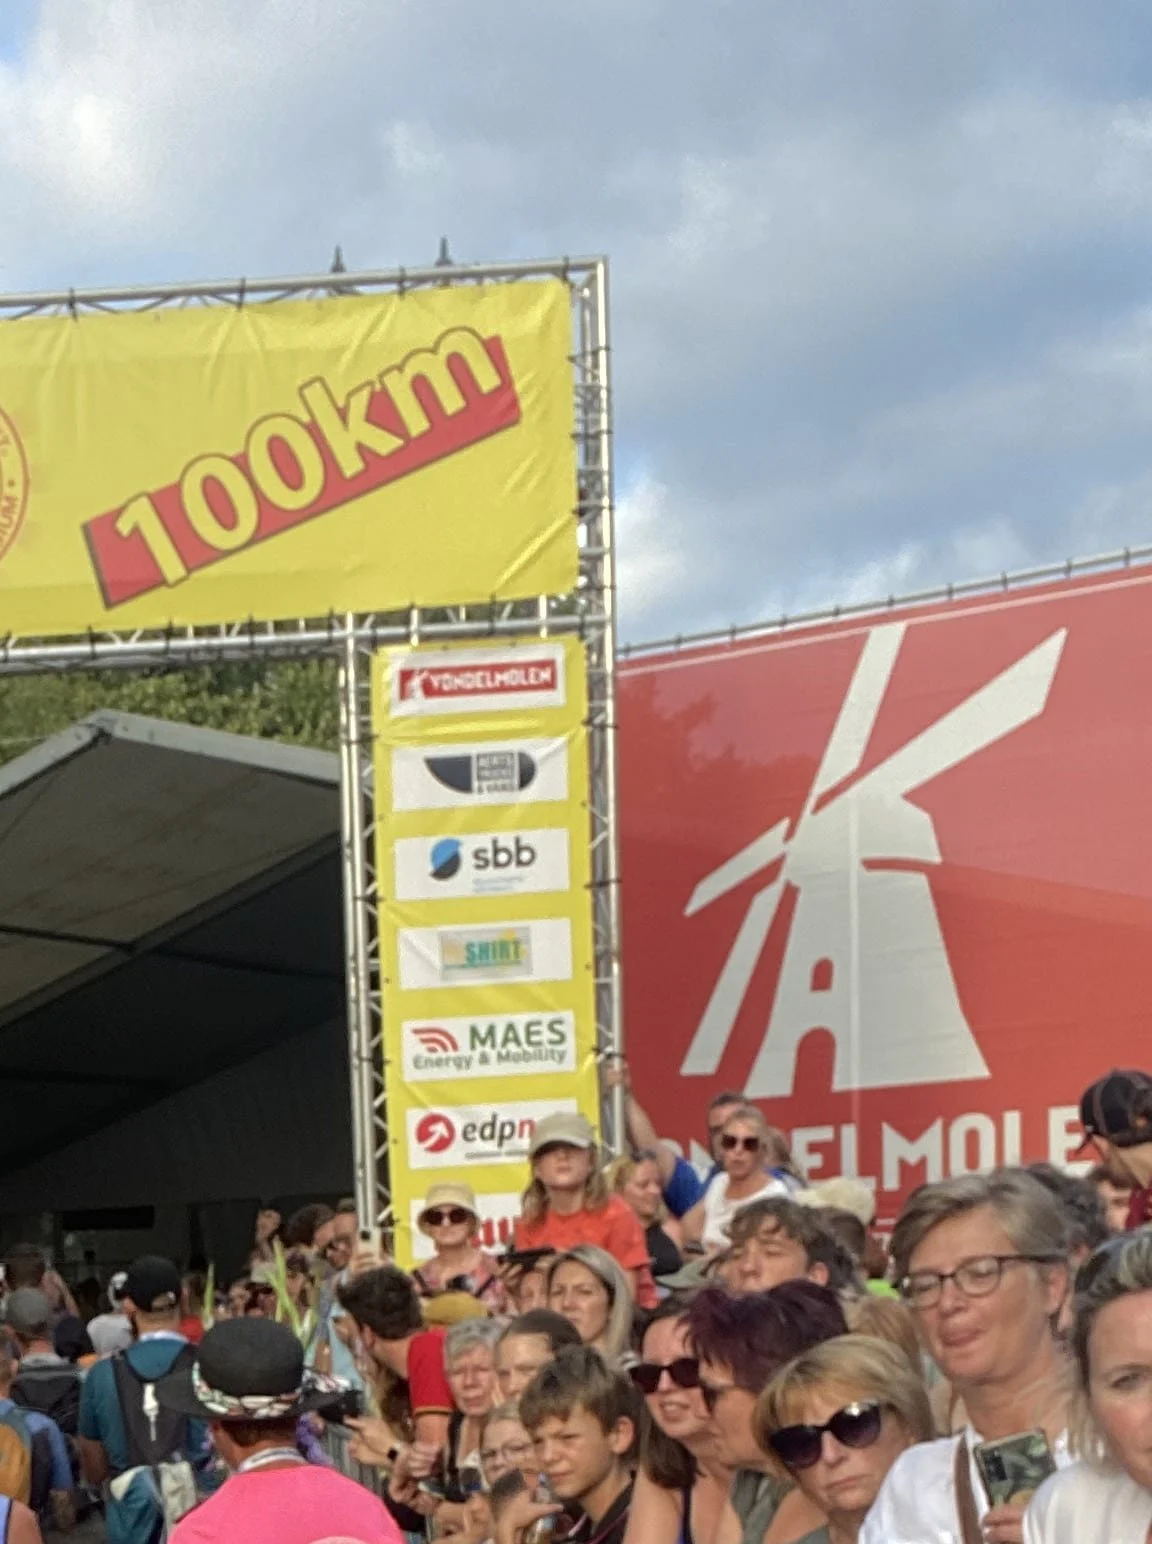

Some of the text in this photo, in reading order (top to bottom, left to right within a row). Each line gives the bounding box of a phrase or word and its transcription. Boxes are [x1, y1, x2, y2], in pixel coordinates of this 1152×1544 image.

[114, 326, 504, 588] 100km
[472, 836, 537, 871] sbb
[469, 1020, 567, 1051] MAES
[412, 1053, 473, 1071] Energy
[497, 1047, 568, 1065] Mobility
[461, 1113, 537, 1146] edpn
